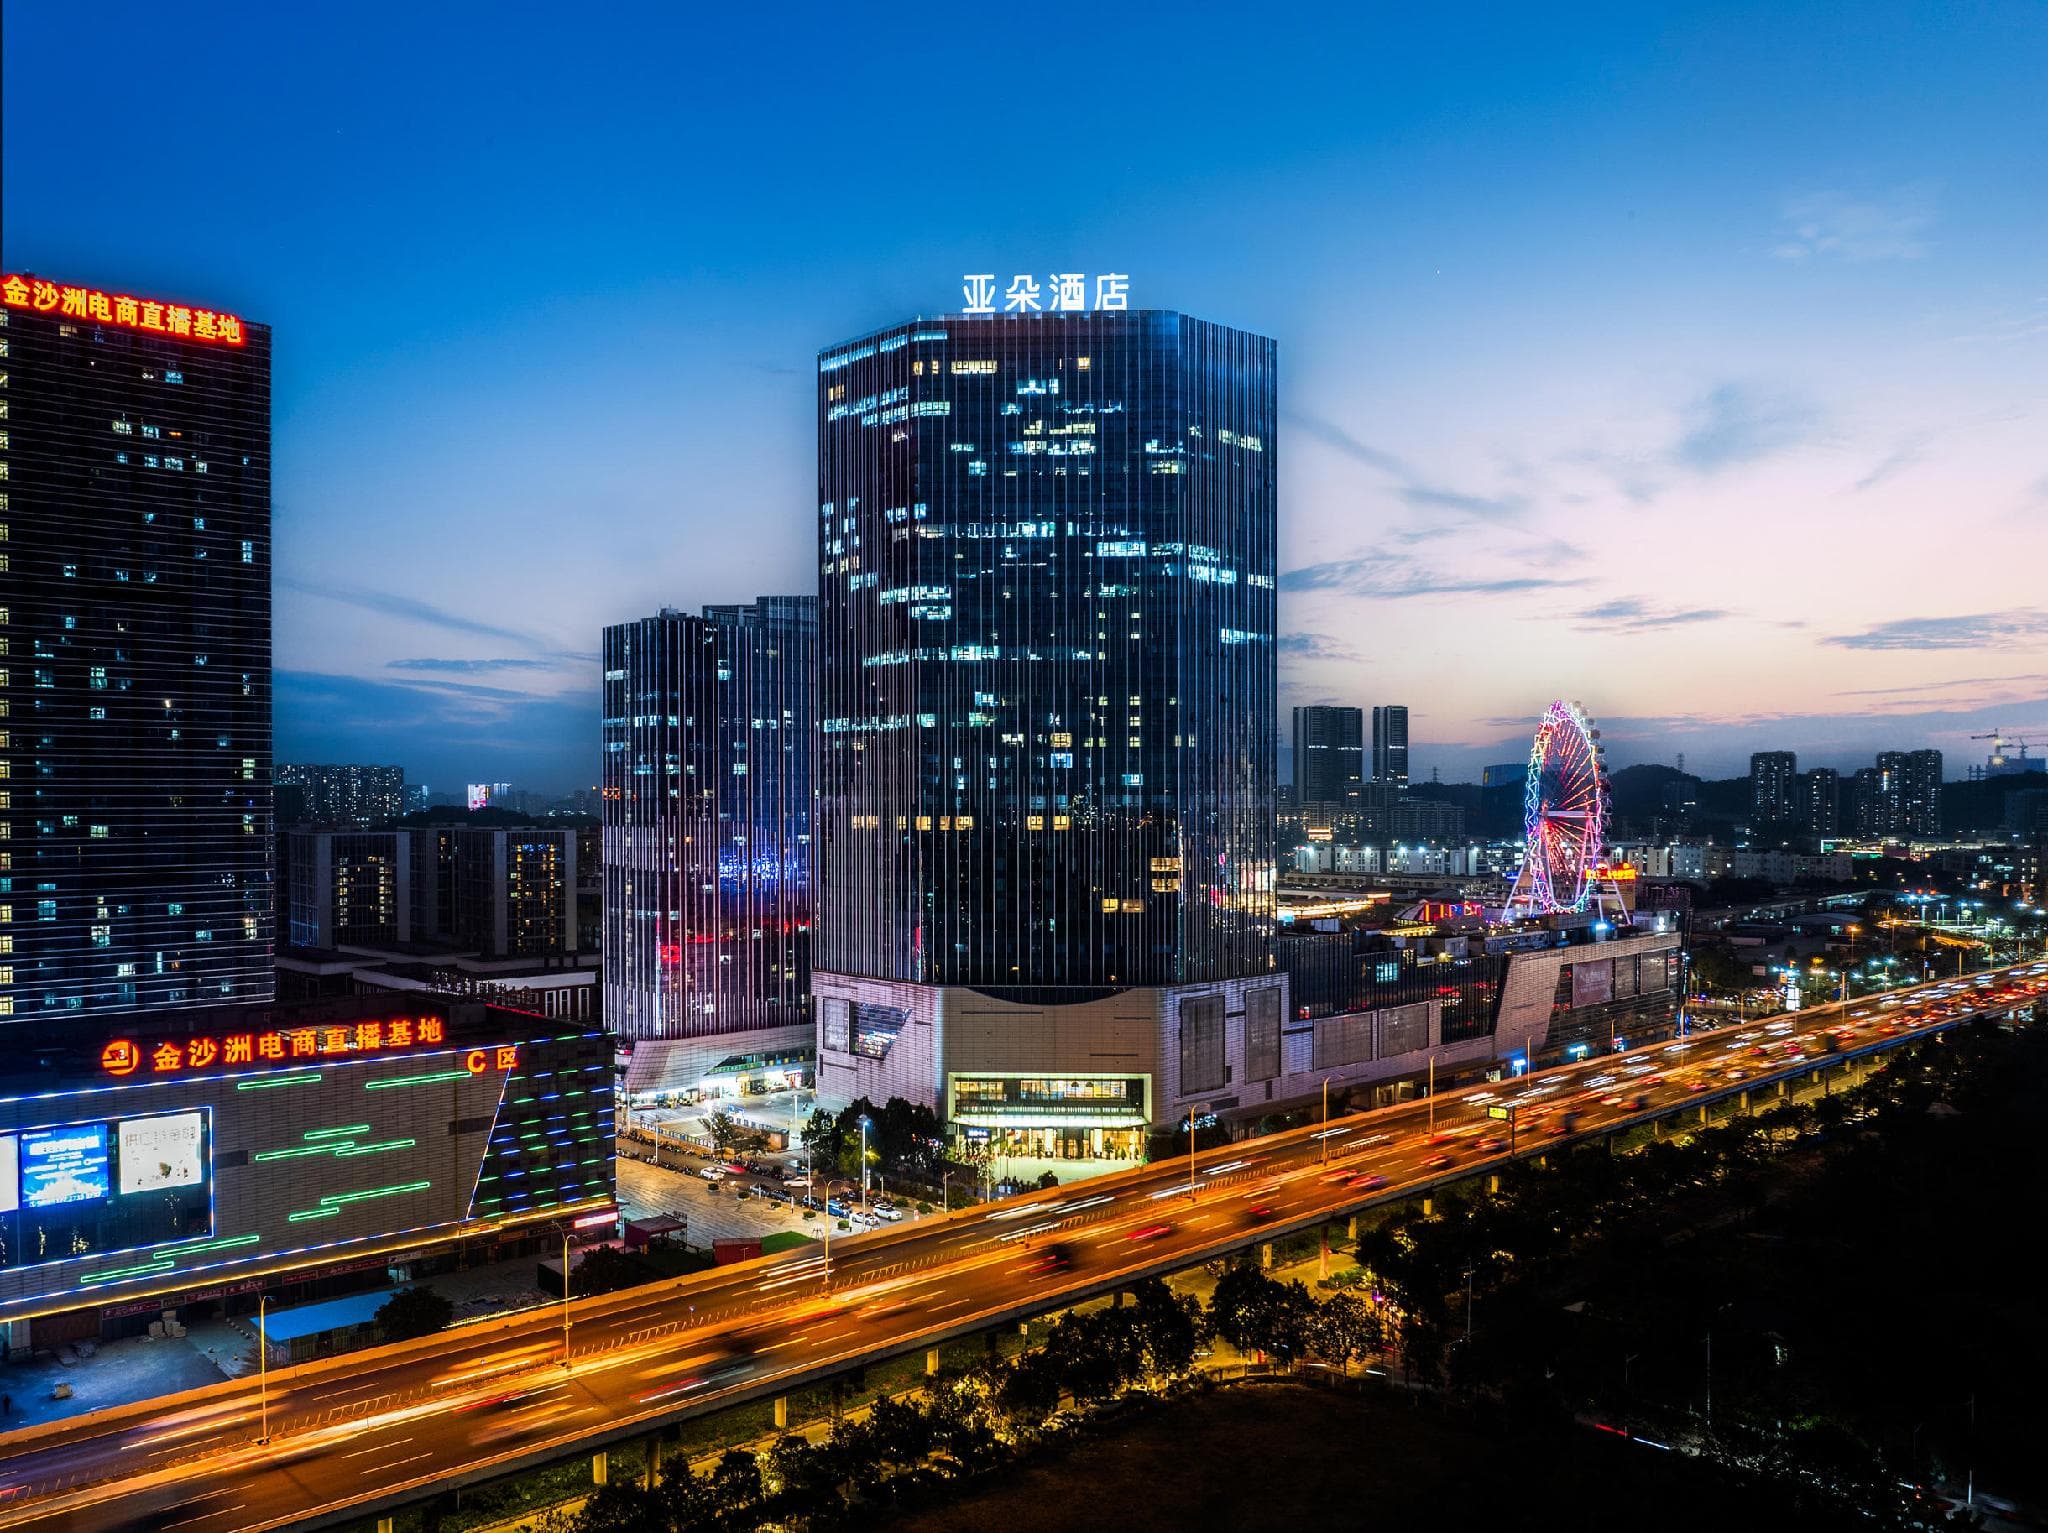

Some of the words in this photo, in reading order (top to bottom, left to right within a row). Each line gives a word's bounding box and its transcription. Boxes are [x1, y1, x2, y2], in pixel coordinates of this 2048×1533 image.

[2, 276, 242, 343] 金沙洲电商直播基地
[962, 272, 1130, 313] 亚朵酒店
[152, 1018, 443, 1073] 金沙洲电商直播基地
